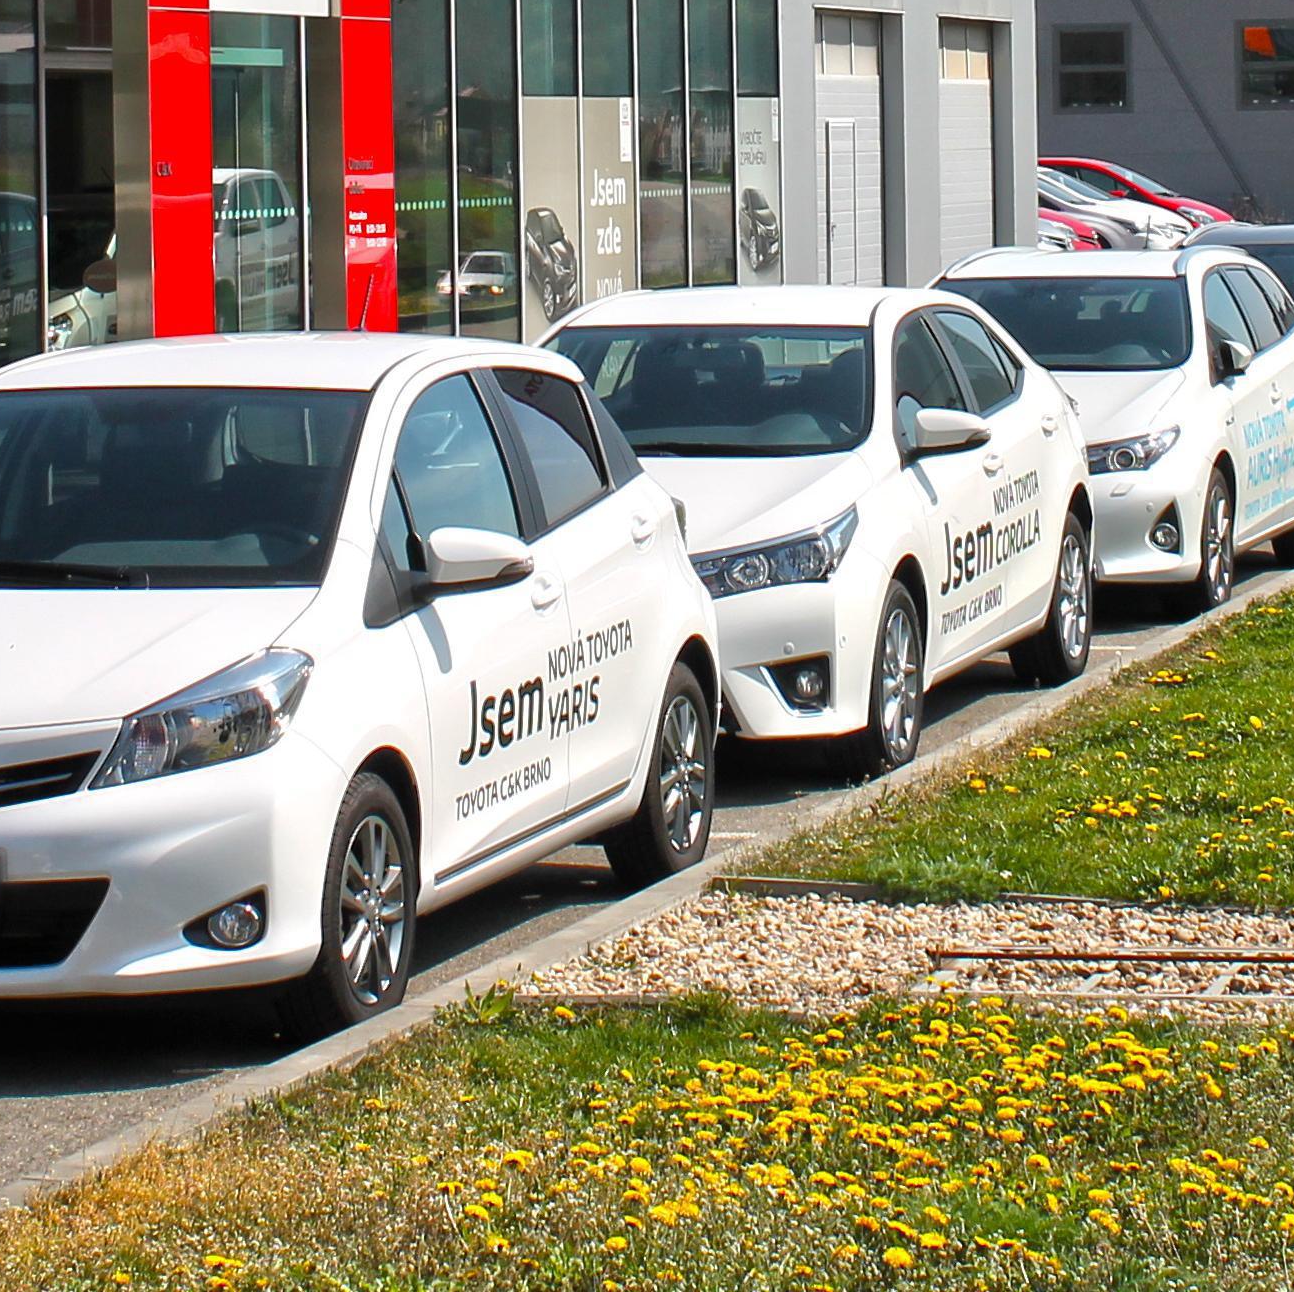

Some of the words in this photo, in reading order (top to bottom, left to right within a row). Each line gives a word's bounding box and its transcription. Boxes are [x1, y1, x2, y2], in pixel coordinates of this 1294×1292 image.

[591, 168, 626, 207] Jsem
[596, 217, 622, 255] zde
[993, 476, 1014, 516] NOVÁ
[1014, 469, 1040, 504] TOYOTA
[940, 520, 993, 596] Jsem
[996, 508, 1040, 565] COROLLA
[940, 603, 967, 636] TOYOTA
[968, 595, 983, 622] C&K
[984, 584, 1003, 614] BRNO
[548, 629, 585, 682] NOVÁ
[586, 618, 633, 666] TOYOTA
[458, 675, 544, 766] Jsem
[548, 675, 600, 740] YARIS
[456, 780, 499, 821] TOYOTA
[500, 773, 522, 801] C&K
[524, 756, 551, 790] BRNO
